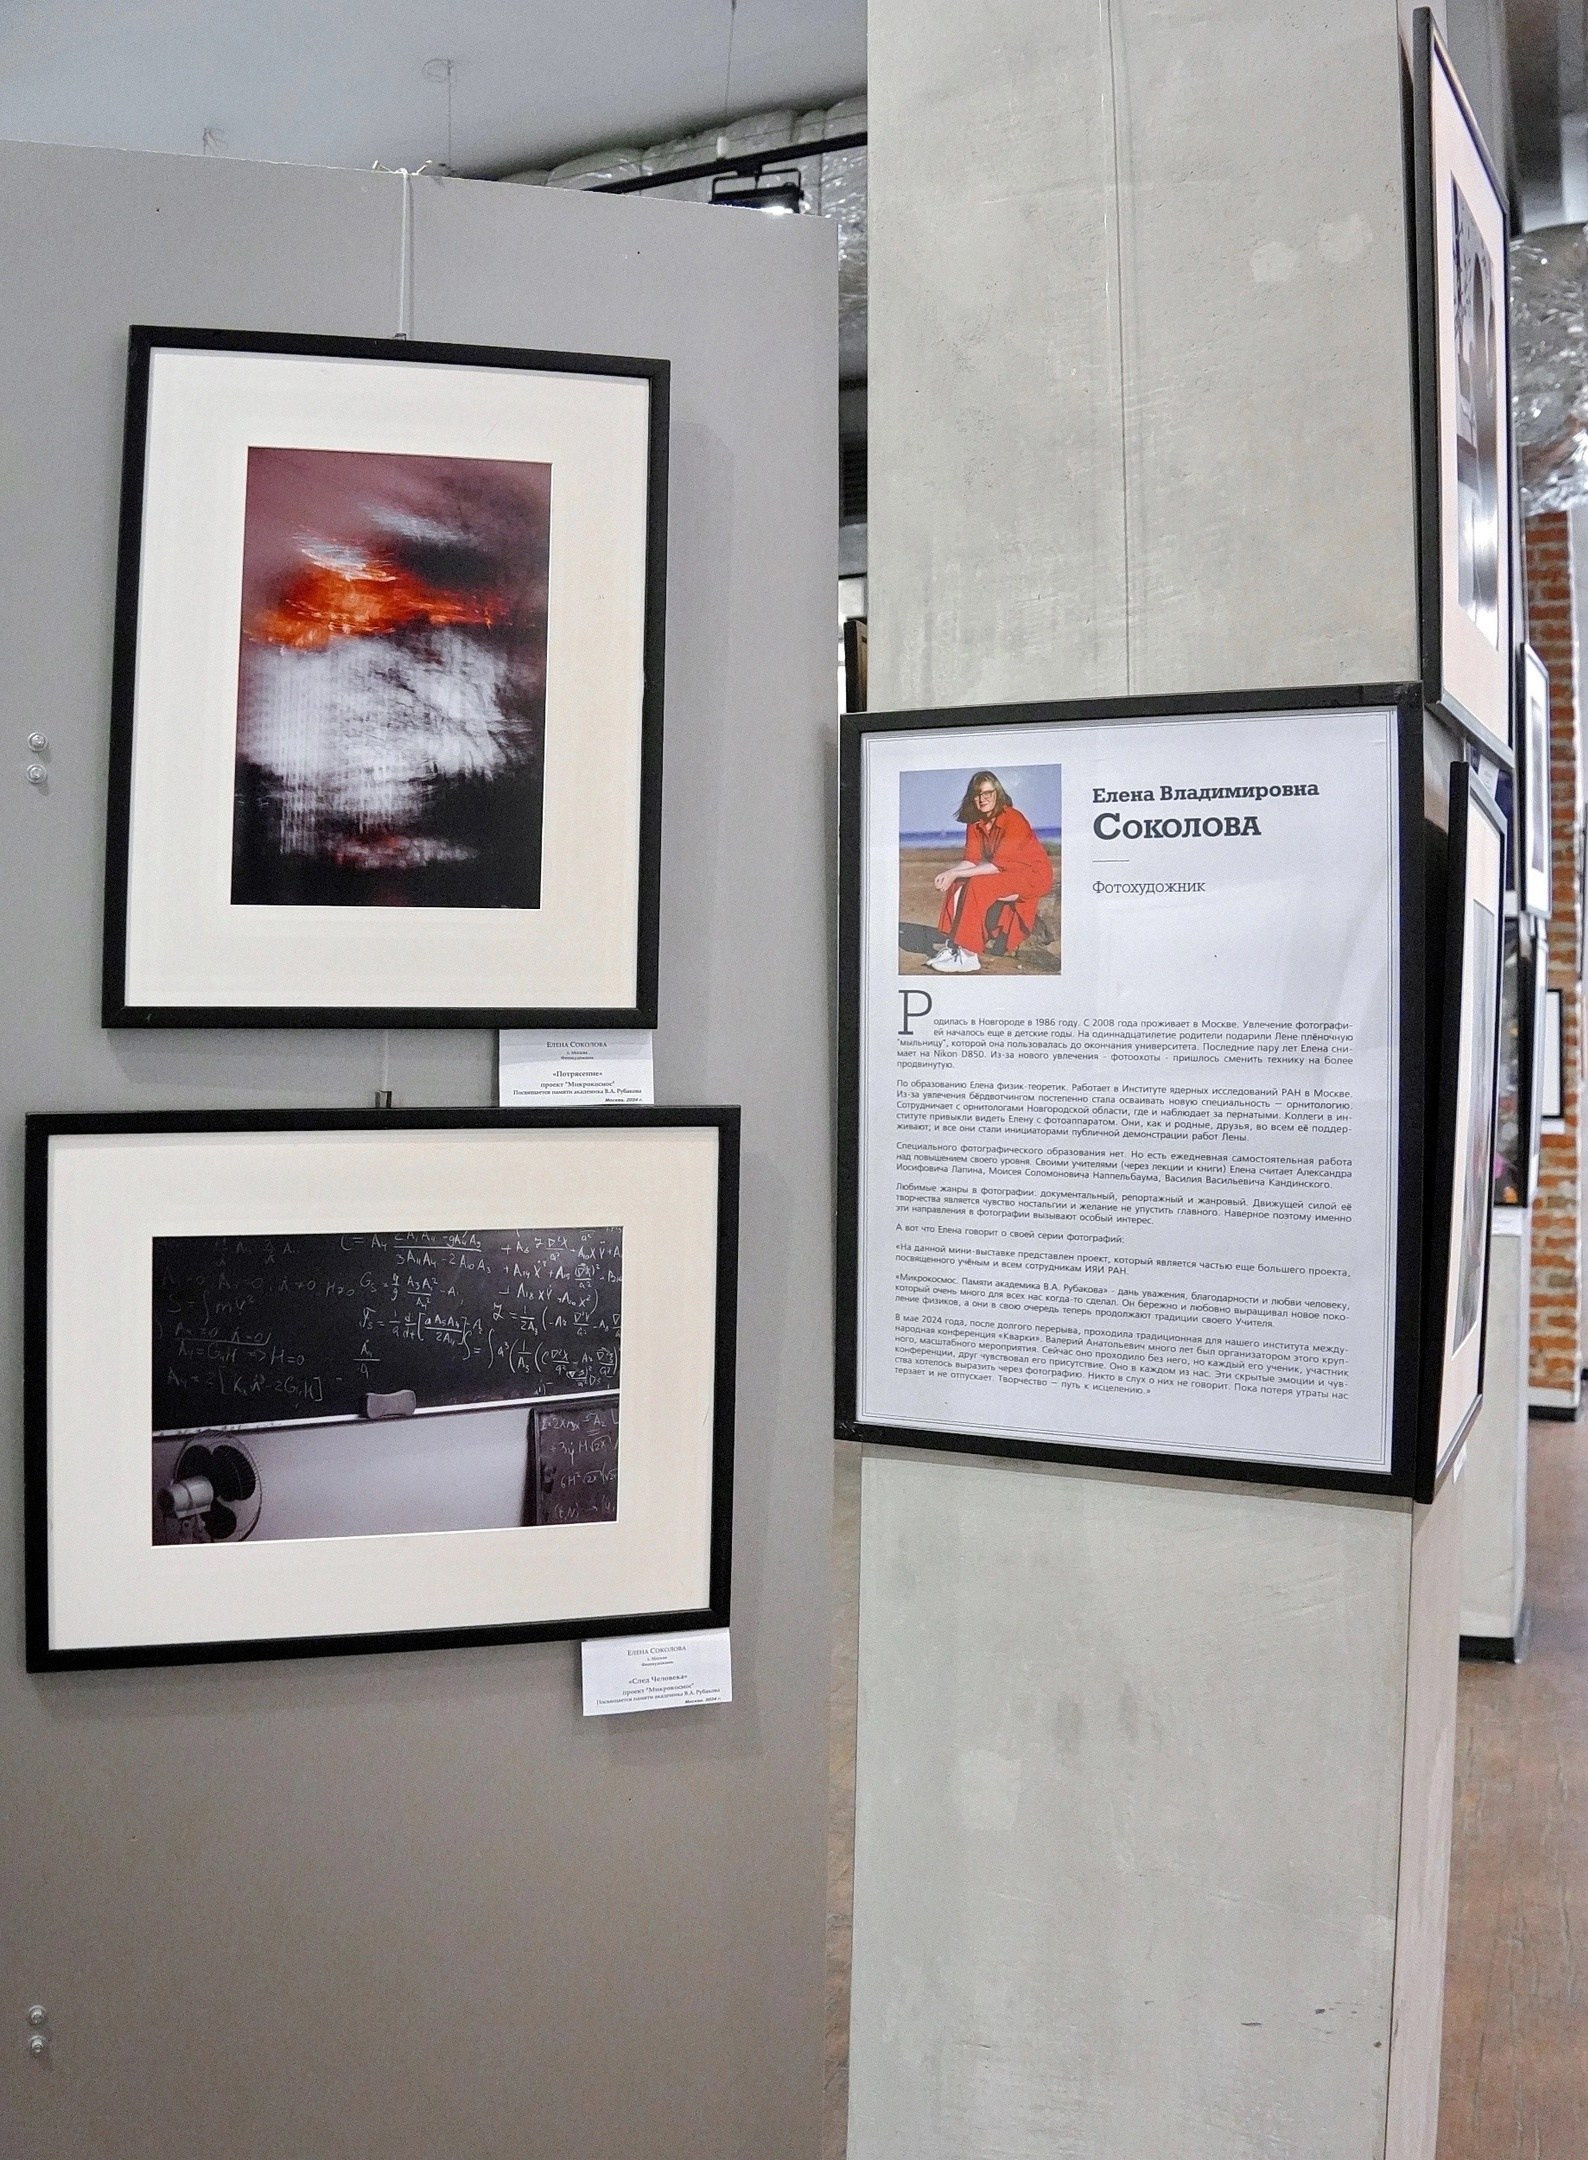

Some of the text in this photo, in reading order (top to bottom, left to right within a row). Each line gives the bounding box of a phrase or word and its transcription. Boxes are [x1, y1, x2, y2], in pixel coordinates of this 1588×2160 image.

[1092, 783, 1320, 803] Елена Владимировна
[1092, 881, 1206, 895] Фотохудожник
[978, 1018, 1025, 1027] Новгороде
[1035, 1018, 1055, 1026] 1986
[1117, 1020, 1137, 1028] года
[1140, 1020, 1190, 1028] проживает
[1242, 1020, 1292, 1028] Увлечение
[933, 1028, 943, 1036] ей
[986, 1030, 1004, 1038] еще
[1014, 1030, 1048, 1038] детские
[1090, 1031, 1176, 1040] одиннадцатилетие
[1179, 1032, 1223, 1040] родители
[1225, 1033, 1271, 1041] подарили
[1274, 1032, 1298, 1040] Лене
[951, 1039, 986, 1048] которой
[1202, 1042, 1254, 1052] Последние
[1257, 1044, 1279, 1053] пару
[1300, 1044, 1328, 1052] Елена
[910, 1080, 967, 1089] образованию
[969, 1081, 994, 1089] Елена
[1071, 1083, 1110, 1091] Работает
[1122, 1084, 1166, 1094] Институте
[1169, 1086, 1208, 1095] ядерных
[1211, 1086, 1278, 1097] исследований
[1281, 1088, 1301, 1096] РАН
[896, 1142, 957, 1152] Специального
[960, 1144, 1043, 1155] фотографического
[1046, 1147, 1105, 1157] образования
[1170, 1152, 1227, 1162] ежедневная
[1231, 1155, 1314, 1164] самостоятельная
[1318, 1156, 1352, 1166] работа
[896, 1164, 948, 1174] Иосифовича
[988, 1167, 1021, 1175] Моисея
[1024, 1168, 1089, 1178] Соломоновича
[1164, 1174, 1202, 1182] Василия
[1205, 1176, 1265, 1185] Васильевича
[911, 1206, 966, 1216] направления
[976, 1208, 1030, 1219] фотографии
[1033, 1212, 1076, 1220] вызывают
[1079, 1213, 1113, 1222] особый
[938, 1226, 962, 1234] Елена
[964, 1228, 998, 1237] говорит
[1009, 1229, 1034, 1238] своей
[1037, 1232, 1063, 1241] серии
[895, 1255, 955, 1266] посвященного
[1024, 1262, 1081, 1273] сотрудникам
[1084, 1265, 1104, 1273] ИЯИ
[896, 1243, 911, 1251] «На
[913, 1244, 946, 1255] данной
[948, 1247, 1015, 1257] мини-выставке
[1017, 1251, 1074, 1262] представлен
[1113, 1255, 1153, 1266] который
[1156, 1259, 1196, 1267] является
[1199, 1261, 1232, 1269] частью
[1235, 1263, 1254, 1272] еще
[1257, 1263, 1305, 1273] большего
[921, 1316, 942, 1324] 2024
[969, 1320, 994, 1328] после
[997, 1322, 1032, 1332] долгого
[1083, 1328, 1133, 1339] проходила
[1134, 1331, 1202, 1344] традиционная
[1205, 1336, 1221, 1345] для
[1224, 1338, 1259, 1347] нашего
[1262, 1341, 1309, 1352] института
[895, 1368, 925, 1377] терзает
[997, 1375, 1047, 1387] Творчество
[1061, 1381, 1080, 1390] путь
